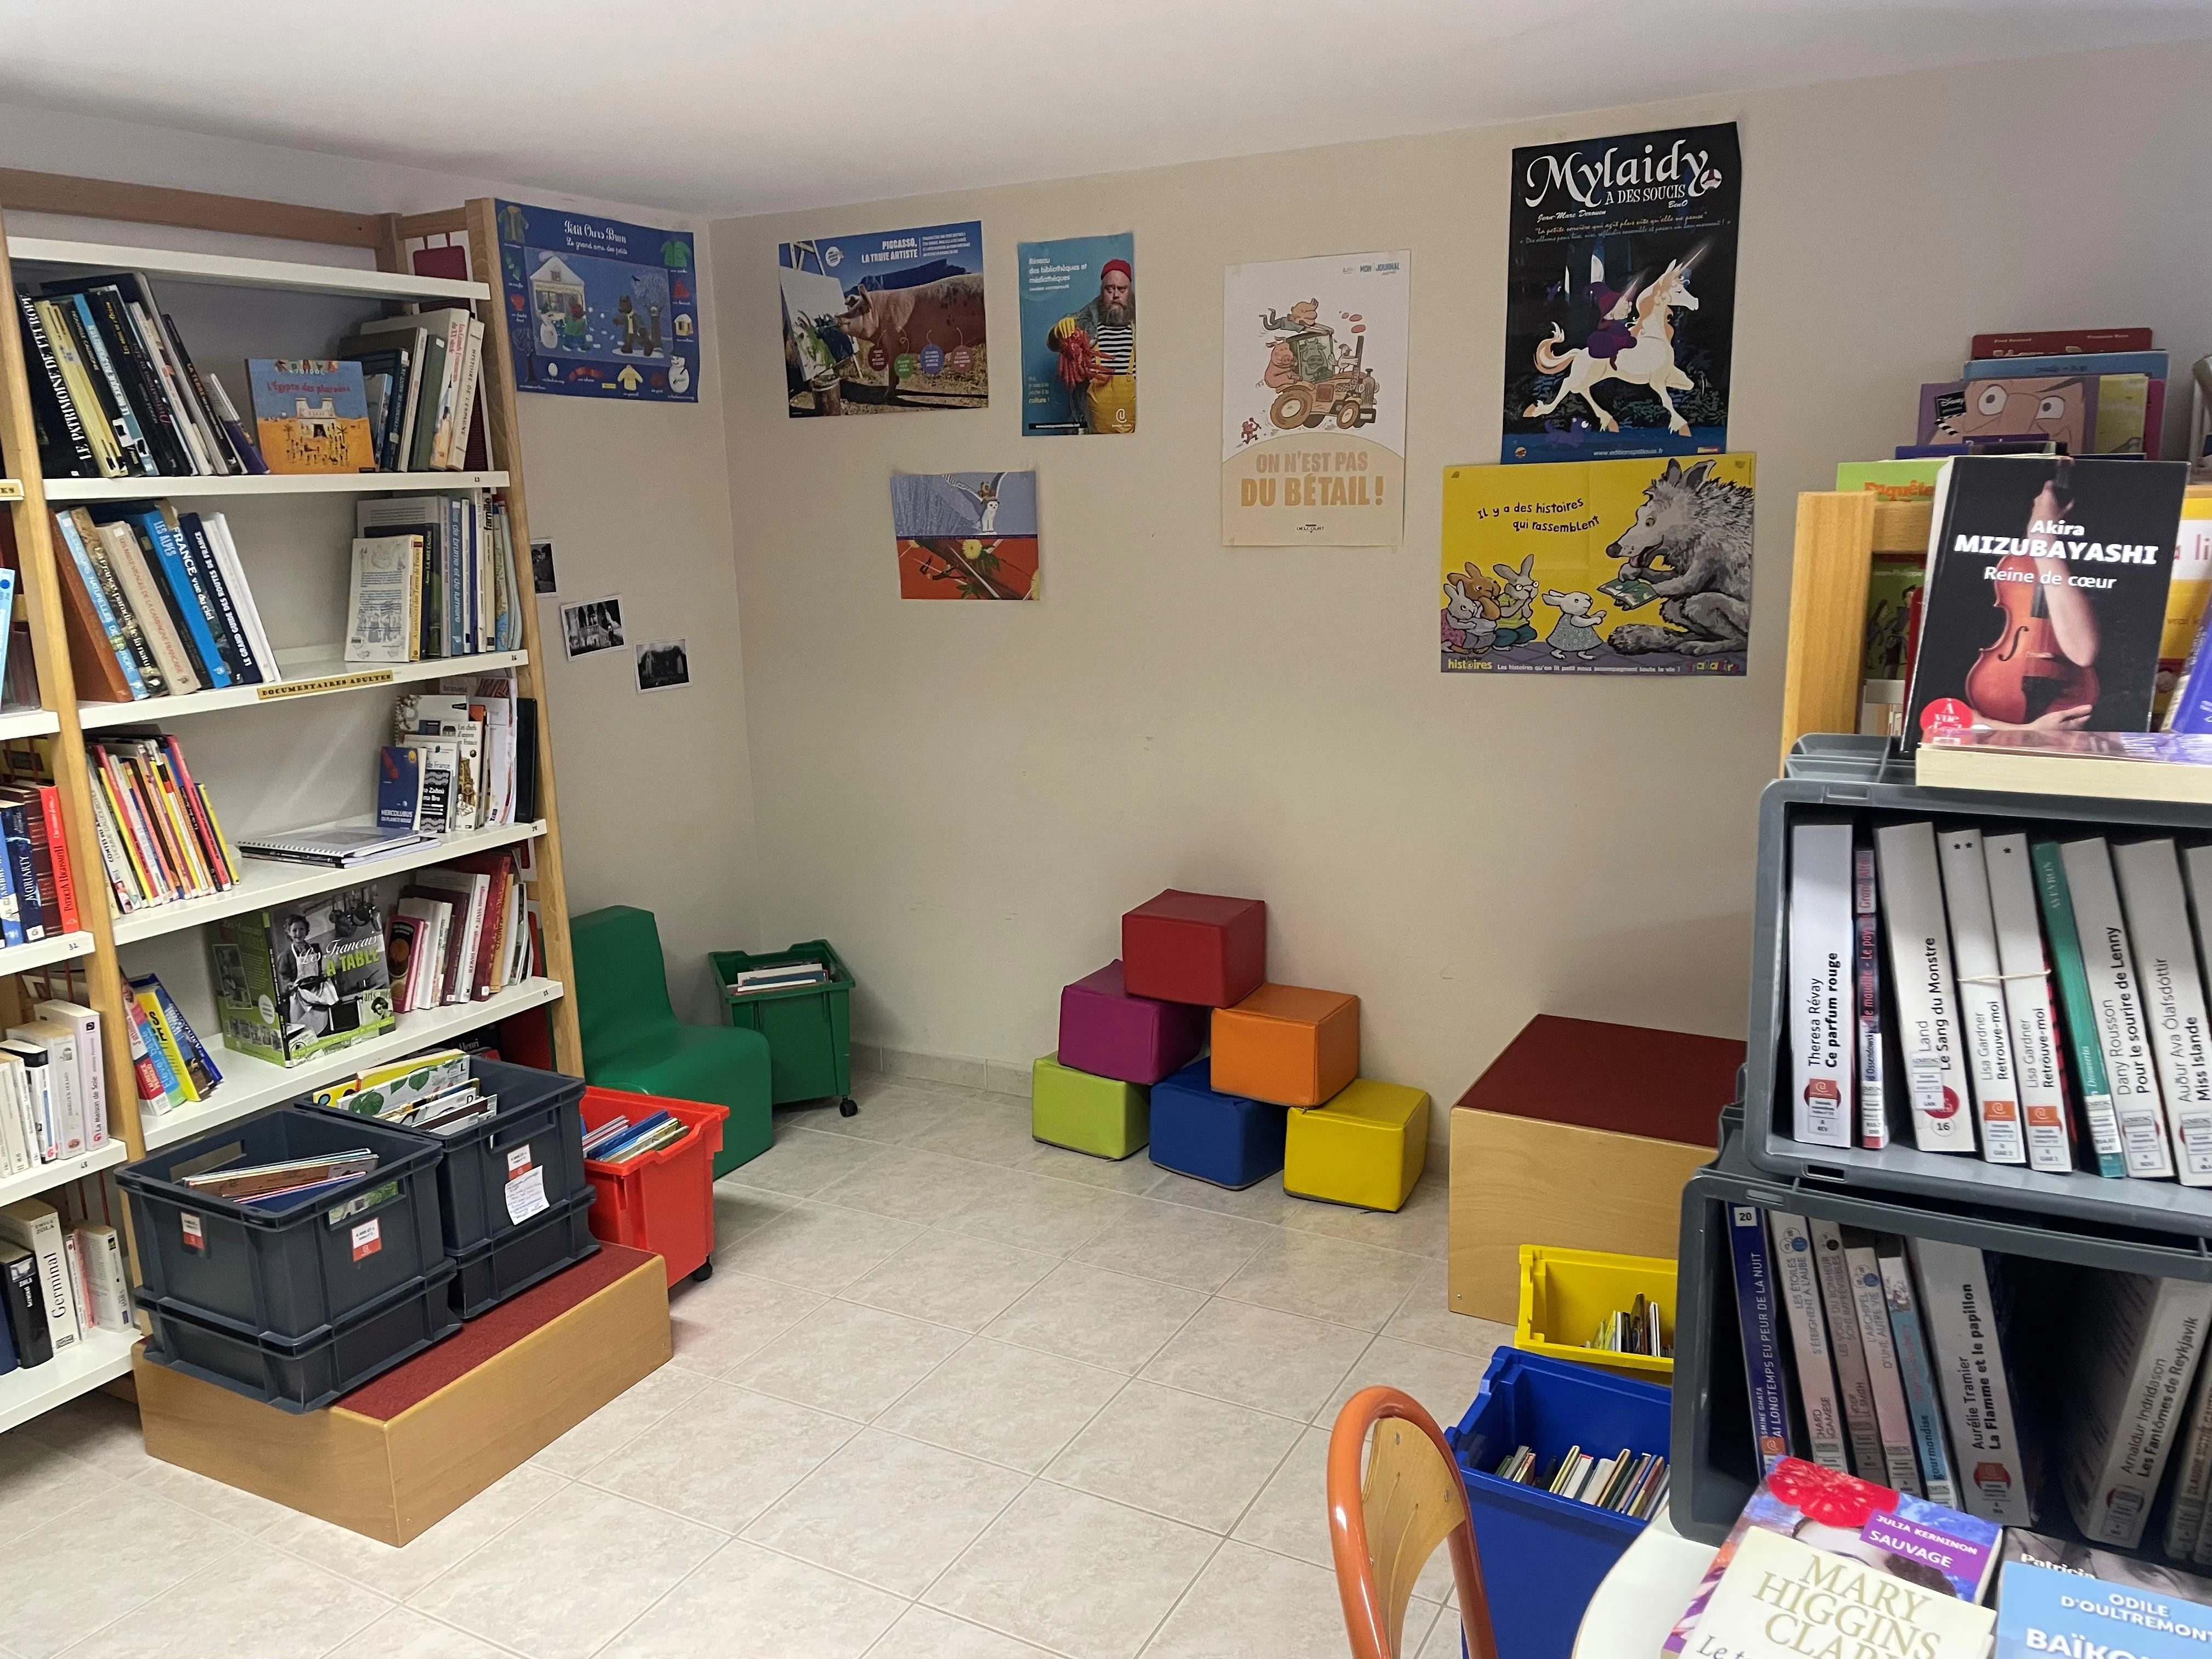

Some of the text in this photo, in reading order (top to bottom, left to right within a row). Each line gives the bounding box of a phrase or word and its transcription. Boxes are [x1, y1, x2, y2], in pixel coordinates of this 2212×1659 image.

[1525, 139, 1709, 208] Mylaidy
[1604, 184, 1686, 205] A DES SOUCIS
[565, 220, 627, 244] Petit Ours Brun
[862, 255, 870, 263] LA
[891, 249, 918, 260] ARTISTE
[40, 351, 57, 370] DE
[47, 369, 84, 442] PATRIMOINE
[75, 442, 92, 461] LE
[1256, 450, 1368, 473] ON N'EST PAS
[1241, 472, 1370, 507] DU BÉTAIL
[484, 497, 493, 531] famille
[1477, 498, 1584, 520] Il y a des histoires
[1513, 515, 1600, 533] qui rassemblent
[2031, 520, 2085, 536] Akira
[1954, 534, 2159, 565] MIZUBAYASHI
[169, 525, 198, 577] FRANCE
[201, 604, 215, 620] ciel
[208, 569, 225, 597] ROUTES
[1984, 566, 2117, 590] Reine de cœur
[219, 596, 231, 611] DES
[225, 611, 239, 633] GUIDE
[242, 657, 252, 667] LE
[262, 674, 392, 696] DOCUMENTAIRES ADULTES
[1934, 714, 1960, 724] vue
[17, 854, 37, 902] MORIARTY
[340, 946, 380, 972] TABLE
[1825, 952, 1841, 1068] Ce parfum rouge
[1923, 936, 1951, 1070] Le Sang du Monstre
[2103, 924, 2151, 1095] Pour le sourire de Lenny
[1808, 978, 1825, 1066] Theresa Révay
[1915, 1019, 1932, 1052] Land
[1973, 1011, 1993, 1081] Lisa Gardner
[2018, 1018, 2039, 1088] Lisa Gardner
[2098, 998, 2133, 1097] Dany Rousson
[2165, 1033, 2184, 1060] Ava
[2182, 1015, 2211, 1103] Miss Islande
[92, 1091, 99, 1099] de
[95, 1124, 103, 1132] La
[1937, 1122, 1950, 1131] 16
[1739, 1211, 1752, 1222] 20
[42, 1251, 66, 1318] Germinal
[1751, 1251, 1781, 1425] LONGTEMPS EU PEUR DE LA NUIT
[2168, 1314, 2203, 1377] Reykjavik
[1959, 1282, 2002, 1451] La Flamme et le papillon
[2162, 1376, 2180, 1395] de
[1955, 1355, 1985, 1451] Aurélie Tramier
[2142, 1393, 2175, 1455] Fantômes
[2117, 1421, 2149, 1475] Arnaldur
[2136, 1455, 2155, 1479] Les
[1868, 1530, 1953, 1568] SAUVAGE
[1876, 1515, 1978, 1555] JULIA KERNINON
[1798, 1554, 1933, 1624] MARY
[1751, 1570, 1942, 1659] HIGGINS
[2109, 1593, 2170, 1618] ODILE
[1696, 1634, 1728, 1659] Le
